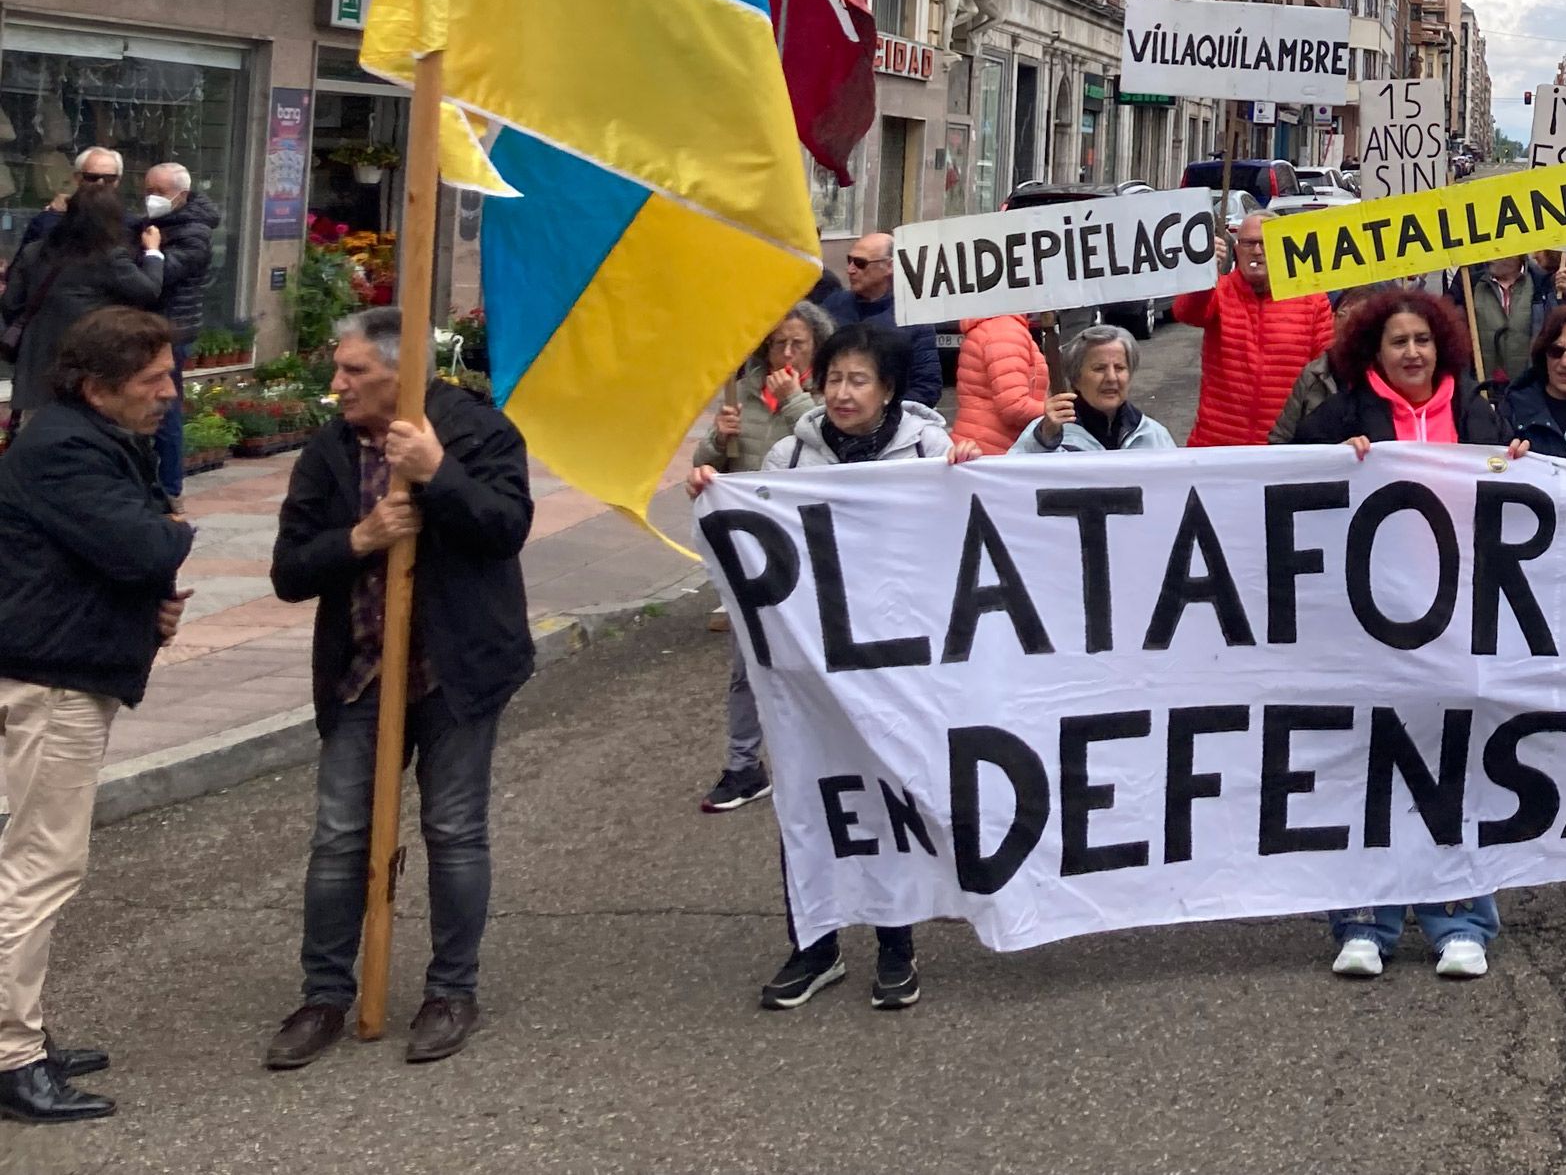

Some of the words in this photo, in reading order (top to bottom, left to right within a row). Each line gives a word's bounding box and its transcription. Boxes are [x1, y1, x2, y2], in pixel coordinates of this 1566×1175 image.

[1379, 82, 1421, 120] 15
[1363, 123, 1442, 163] AÑOS
[1376, 161, 1436, 199] SIN
[818, 774, 938, 858] EN
